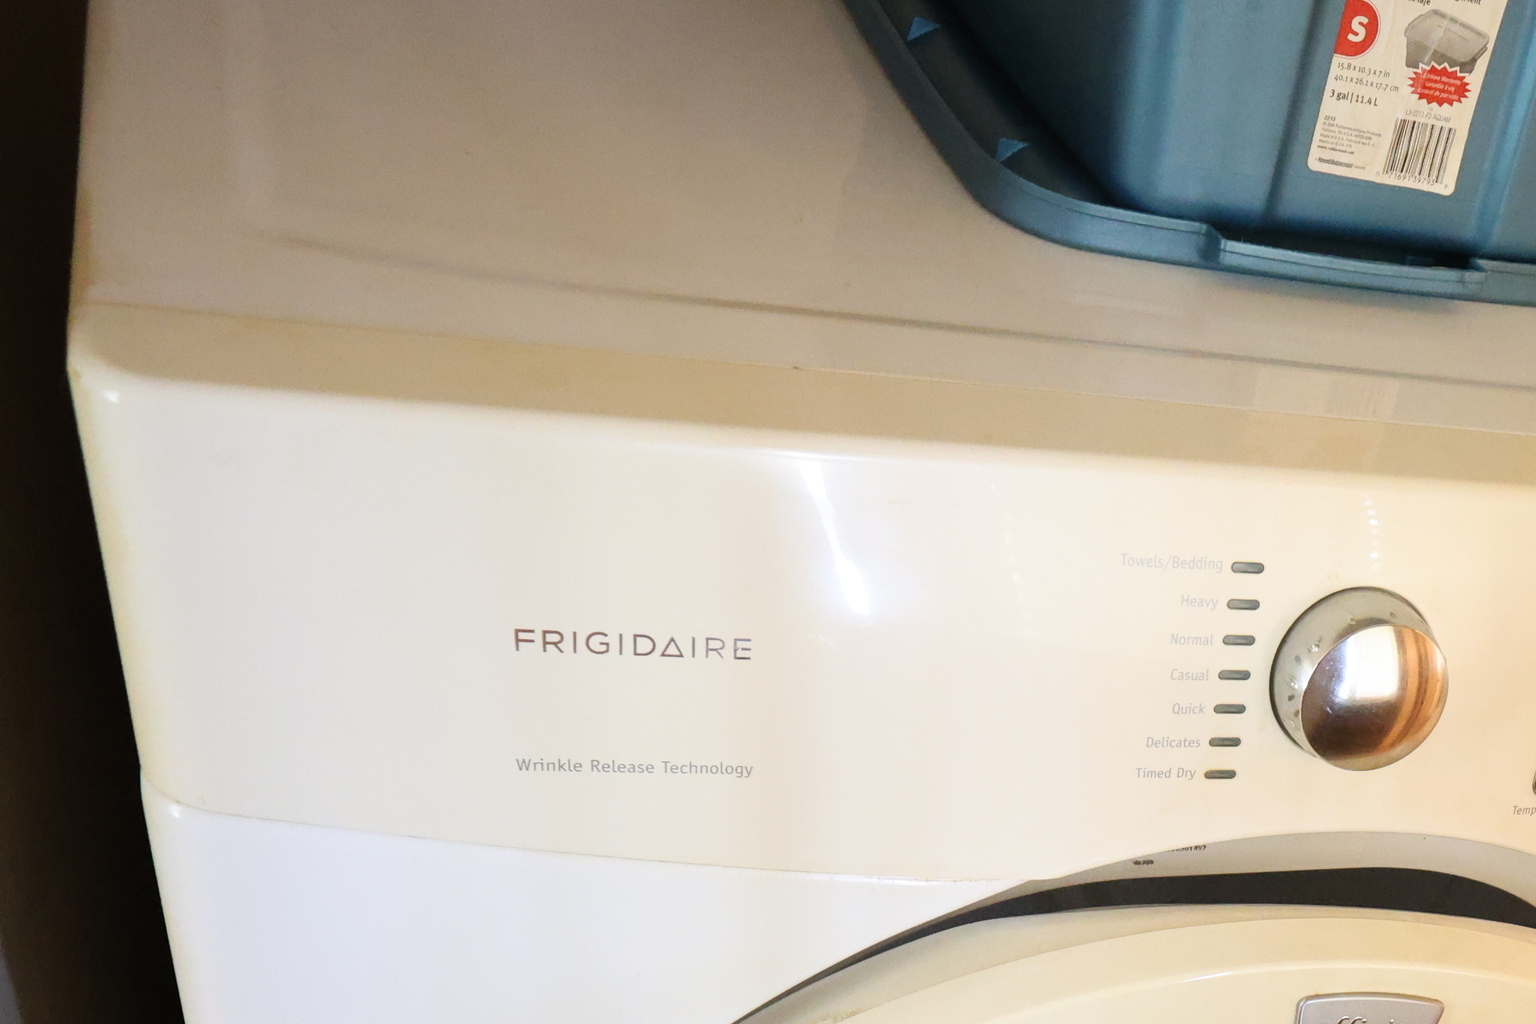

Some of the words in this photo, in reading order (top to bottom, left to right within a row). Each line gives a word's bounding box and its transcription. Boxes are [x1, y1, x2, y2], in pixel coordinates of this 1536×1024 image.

[1347, 15, 1369, 43] S
[1337, 62, 1352, 71] 15.8
[1358, 66, 1372, 76] 10.3
[1383, 70, 1390, 78] in
[1334, 74, 1349, 83] 40.1
[1354, 78, 1369, 87] 26.1
[1375, 82, 1389, 92] 17.7
[1329, 89, 1335, 98] 3
[1336, 90, 1350, 102] gal
[1354, 94, 1372, 106] 11.4
[1121, 553, 1223, 574] Towels/Bedding
[1180, 594, 1219, 612] Heavy
[514, 628, 752, 660] FRIGIDAIRE
[1169, 633, 1214, 647] Normal
[1170, 668, 1210, 682] Casual
[1171, 702, 1206, 716] Quick
[1145, 735, 1202, 749] Delicates
[515, 758, 583, 773] Wrinkle
[590, 759, 655, 775] Release
[661, 760, 754, 779] Technology
[1135, 767, 1172, 780] Timed
[1176, 767, 1197, 781] Dry
